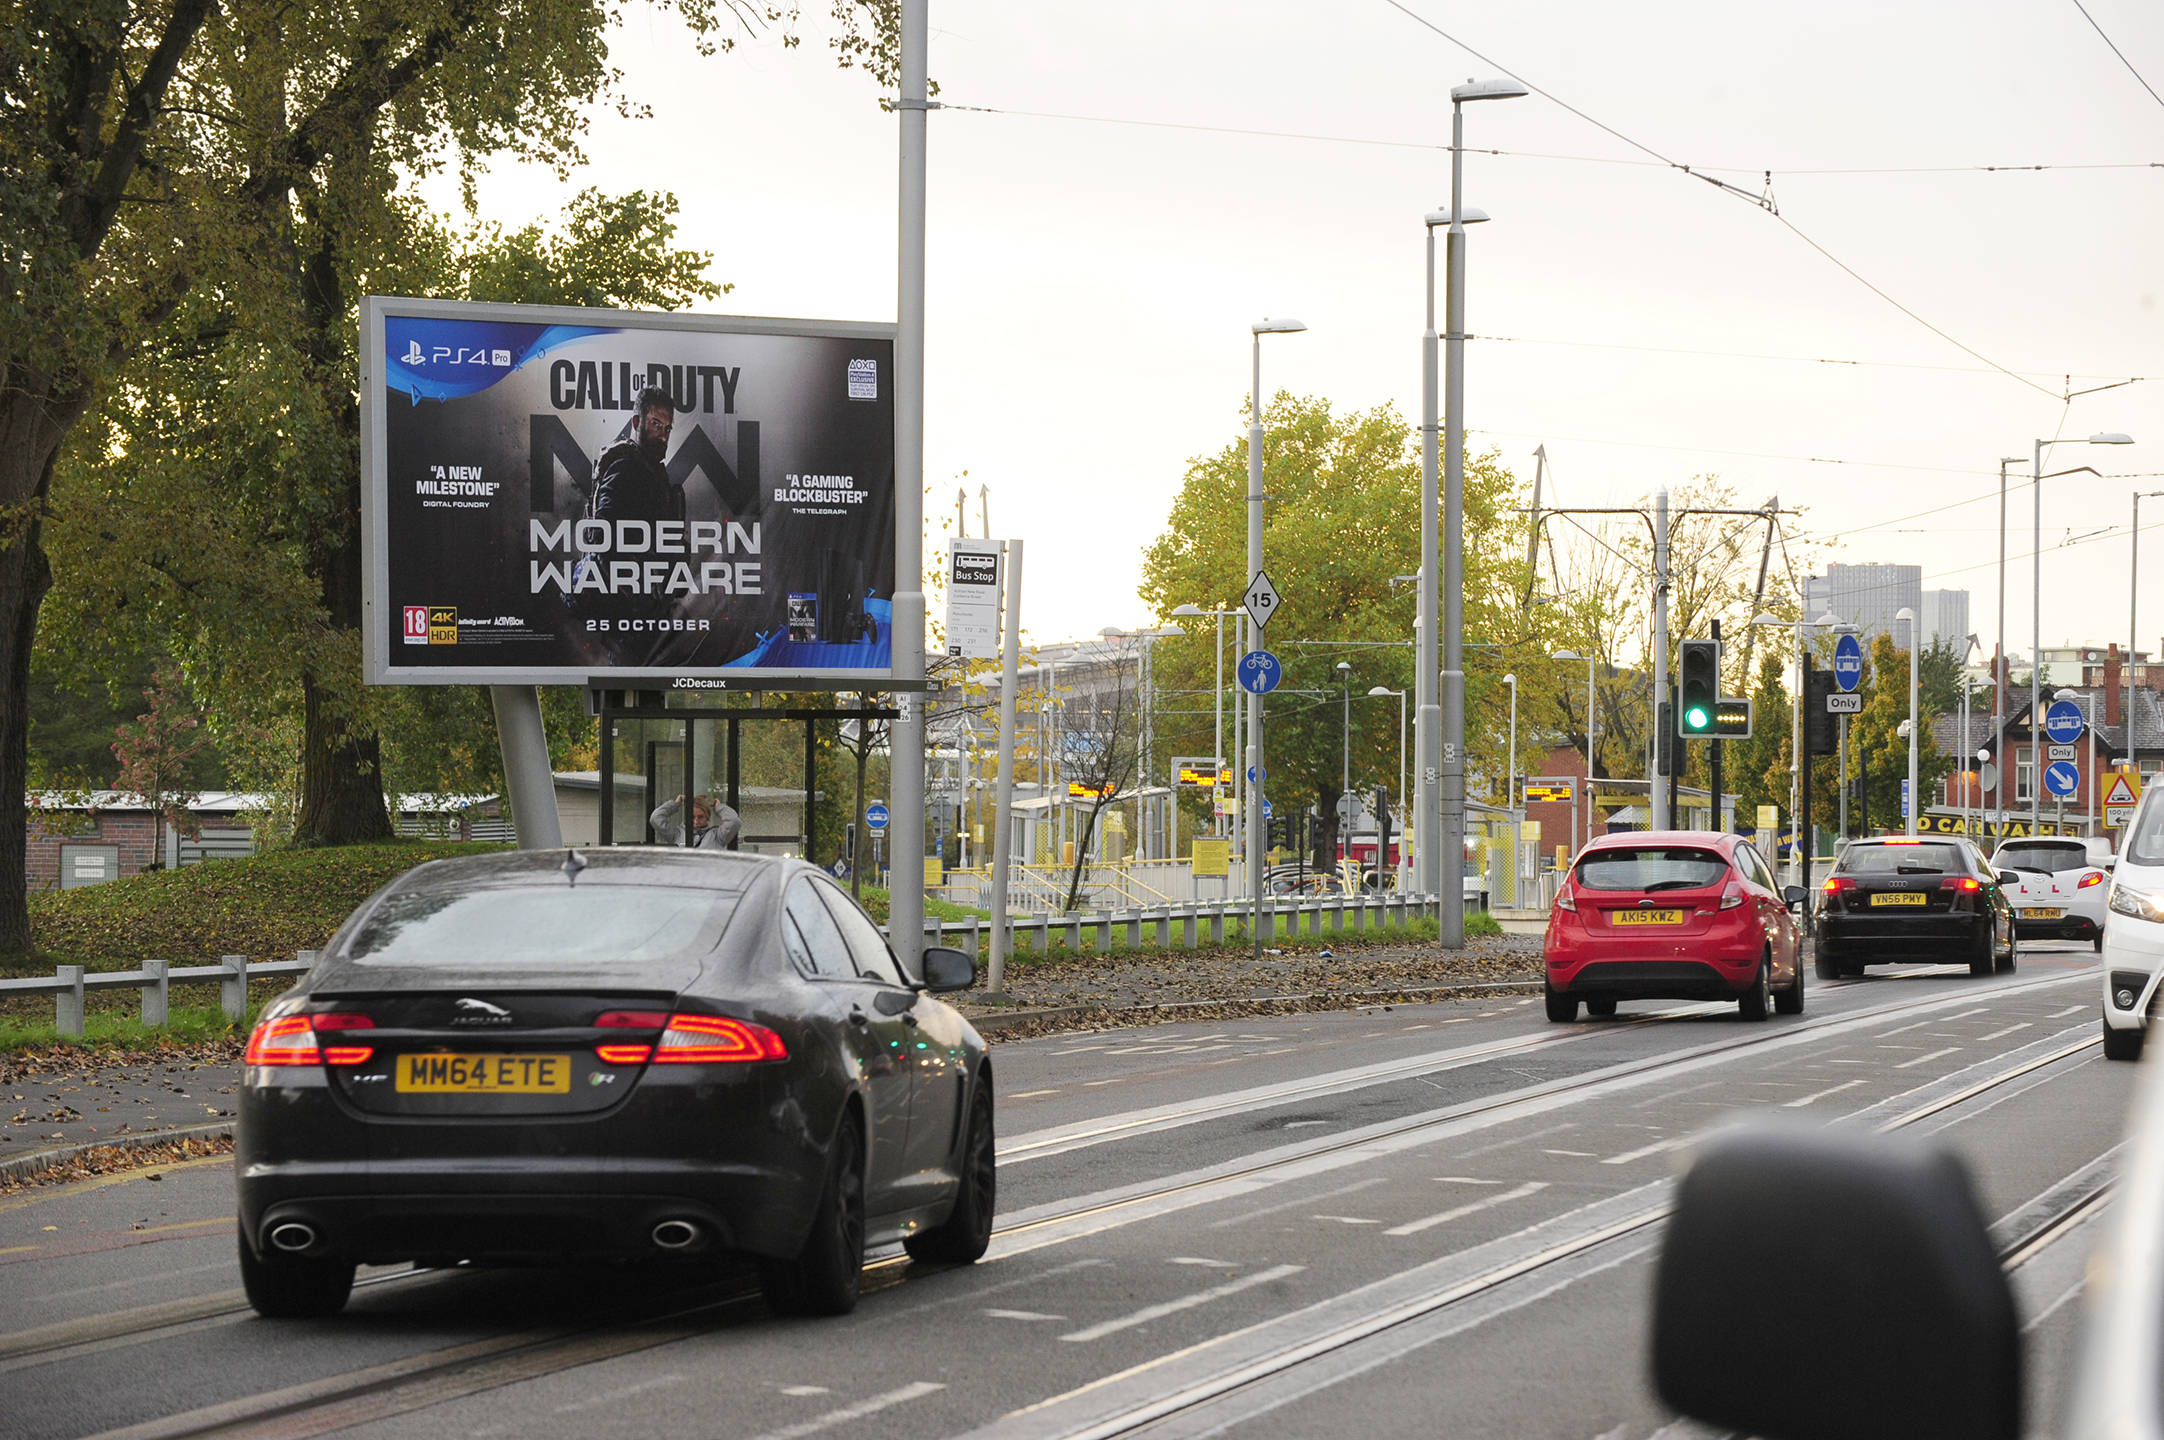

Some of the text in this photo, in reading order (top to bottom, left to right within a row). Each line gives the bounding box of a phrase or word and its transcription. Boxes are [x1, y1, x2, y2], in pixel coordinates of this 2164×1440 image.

[433, 346, 508, 366] PS4 Pro
[550, 359, 741, 414] CALL OF DUTY
[448, 466, 482, 480] NEW
[802, 474, 854, 489] GAMING
[530, 518, 761, 554] MODERN
[530, 560, 762, 595] WARFARE
[956, 570, 994, 583] Bus Stop
[1252, 592, 1271, 608] 15
[406, 610, 426, 634] 18
[431, 612, 454, 622] 4K
[583, 619, 710, 631] 25 OCTOBER
[431, 630, 456, 641] HDR
[672, 678, 726, 688] JCDecaux
[1831, 698, 1857, 709] Only
[2052, 748, 2072, 757] Only
[1937, 818, 1982, 834] CAR
[2020, 884, 2060, 894] L L
[1876, 894, 1922, 903] VN56 PMY
[1620, 911, 1674, 922] AK15 KWZ
[2022, 908, 2060, 918] ML64 RMU
[450, 1016, 512, 1025] JAGUAR
[410, 1058, 556, 1086] MM64 ETE
